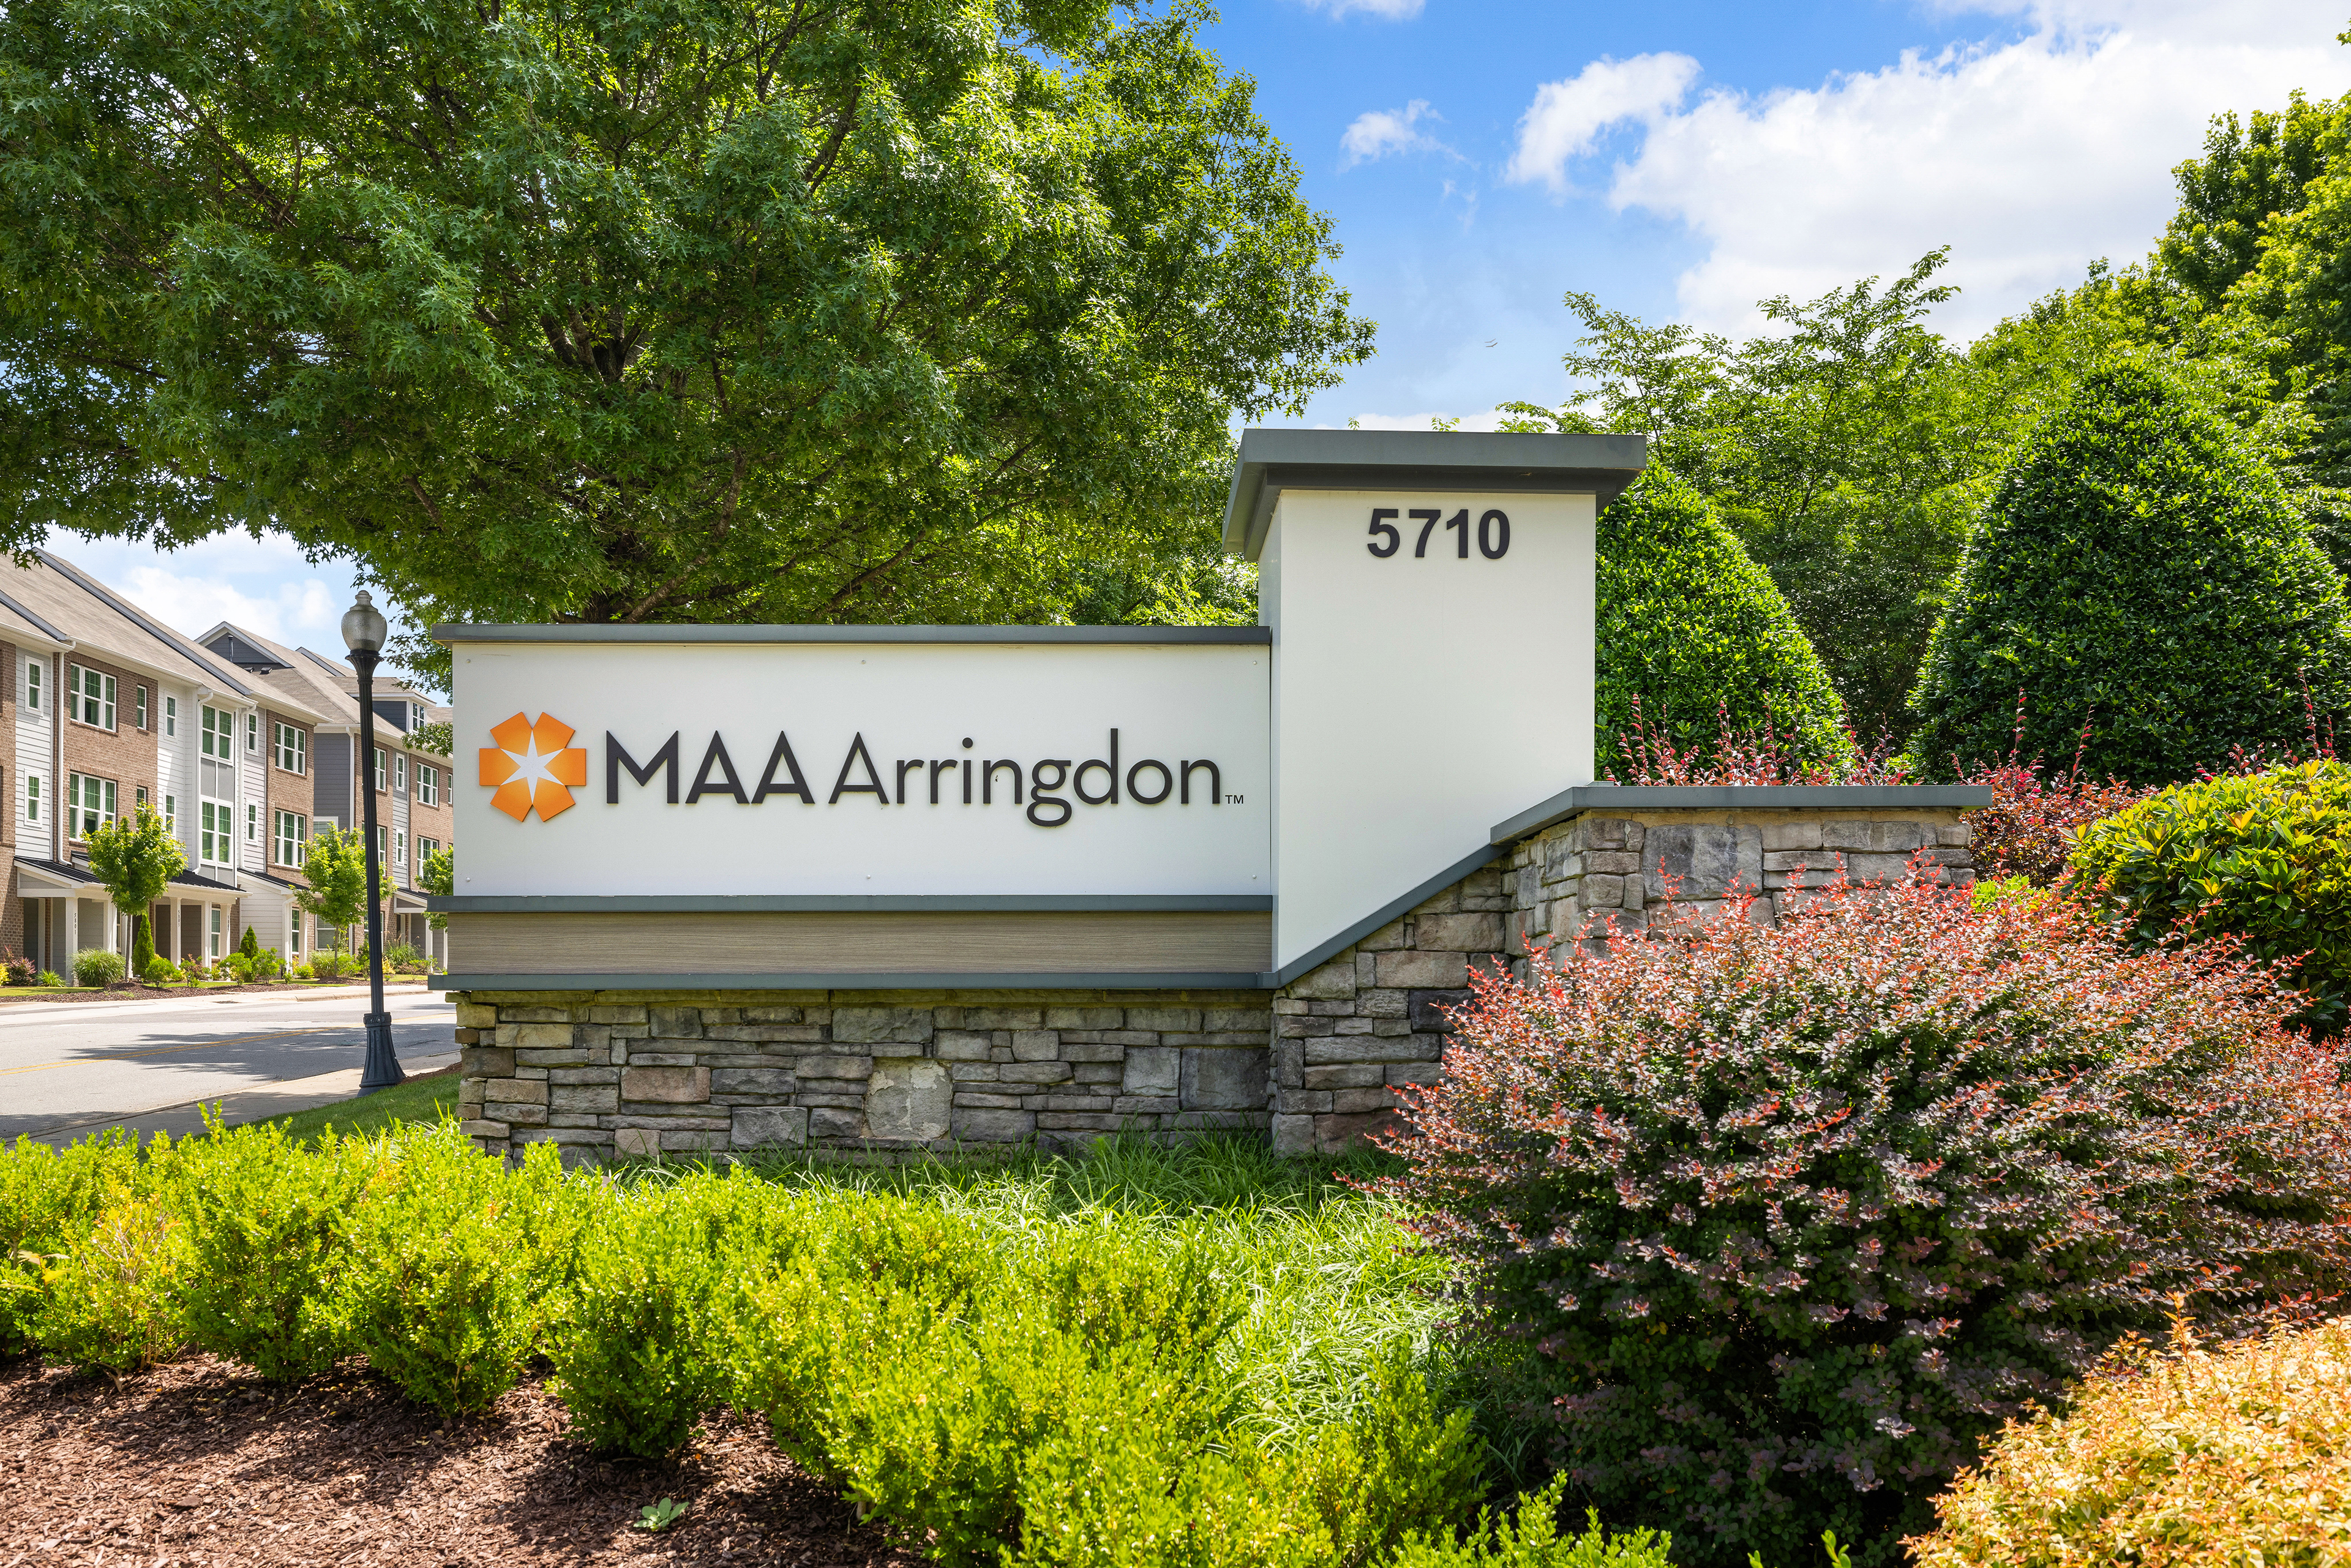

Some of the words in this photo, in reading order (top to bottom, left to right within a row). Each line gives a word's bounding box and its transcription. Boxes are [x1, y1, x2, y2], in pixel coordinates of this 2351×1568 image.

[1367, 508, 1510, 560] 5710
[606, 730, 816, 805] MAA
[828, 729, 1221, 828] Arringdon
